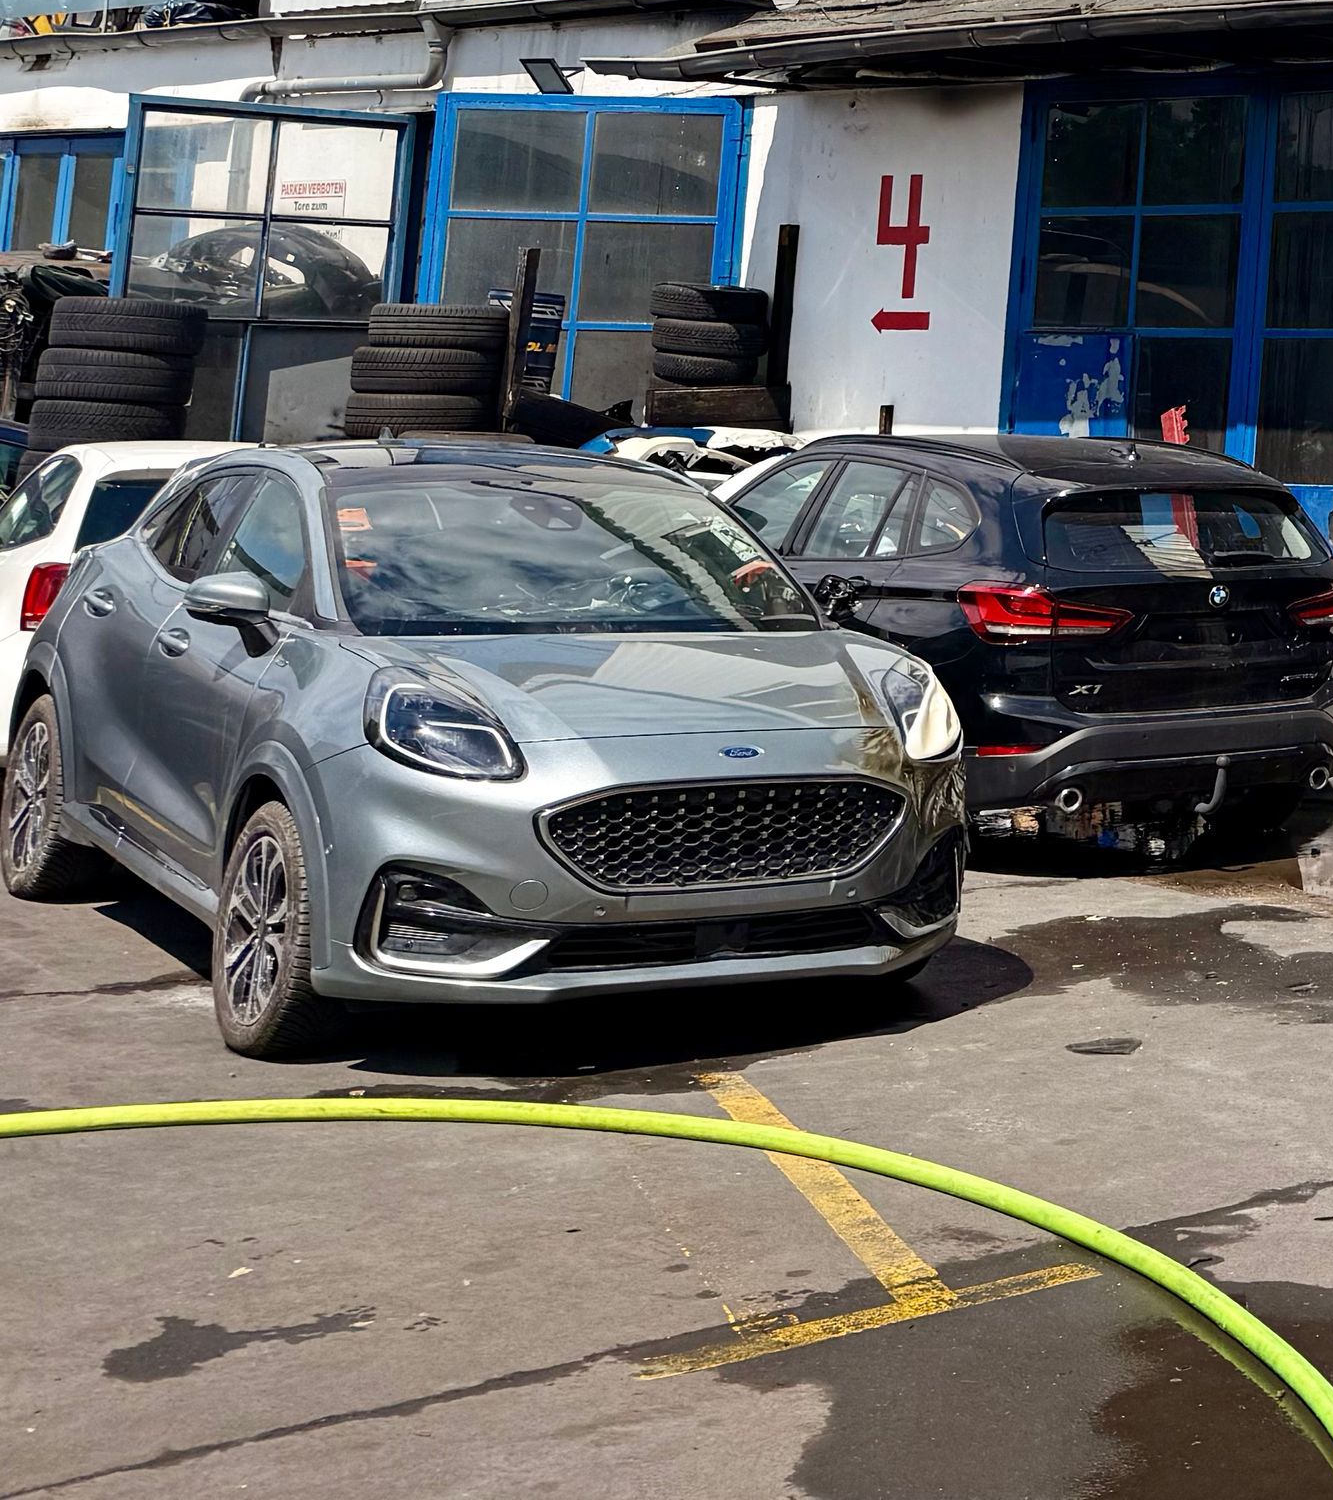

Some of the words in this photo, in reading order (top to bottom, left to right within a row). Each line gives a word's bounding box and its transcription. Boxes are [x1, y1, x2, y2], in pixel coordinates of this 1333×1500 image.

[281, 183, 307, 195] PARKEN
[308, 182, 343, 195] VERBOTEN
[294, 201, 310, 211] Tore
[311, 202, 328, 211] zum
[877, 174, 930, 299] 4
[1068, 684, 1103, 696] X1
